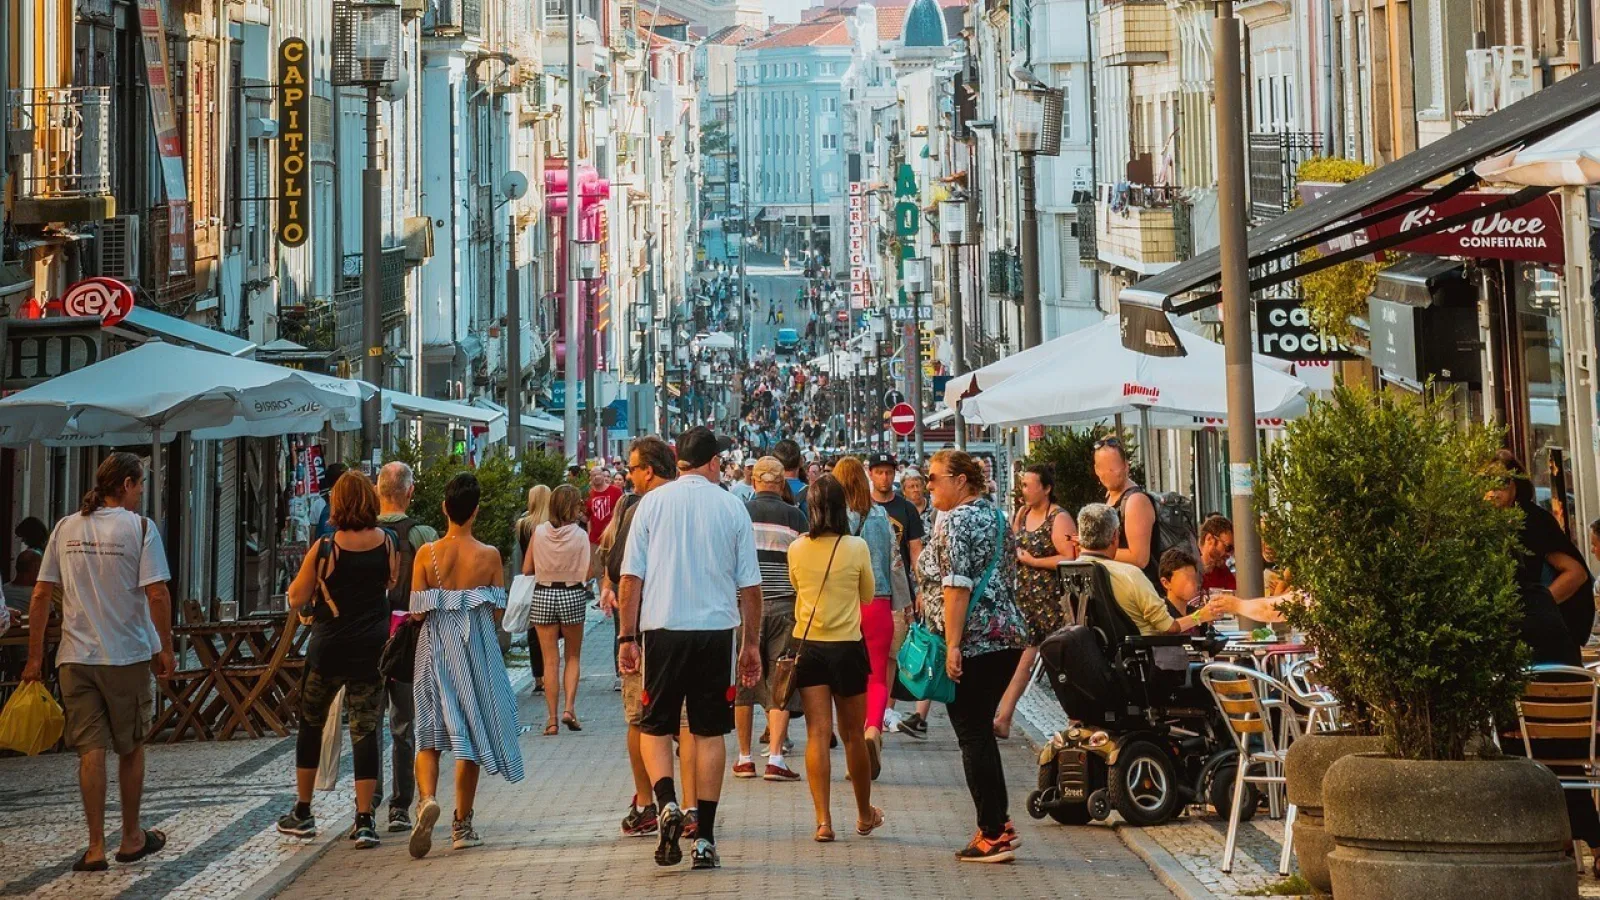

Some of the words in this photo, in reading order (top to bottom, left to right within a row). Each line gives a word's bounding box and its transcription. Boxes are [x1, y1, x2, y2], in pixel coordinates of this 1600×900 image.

[283, 42, 305, 242] CAPITÓLIO
[851, 183, 861, 292] PERFECTA
[1460, 236, 1547, 248] CONFEITARIA
[890, 306, 931, 319] BAZAR
[1263, 330, 1349, 353] roch
[1064, 786, 1083, 797] Street
